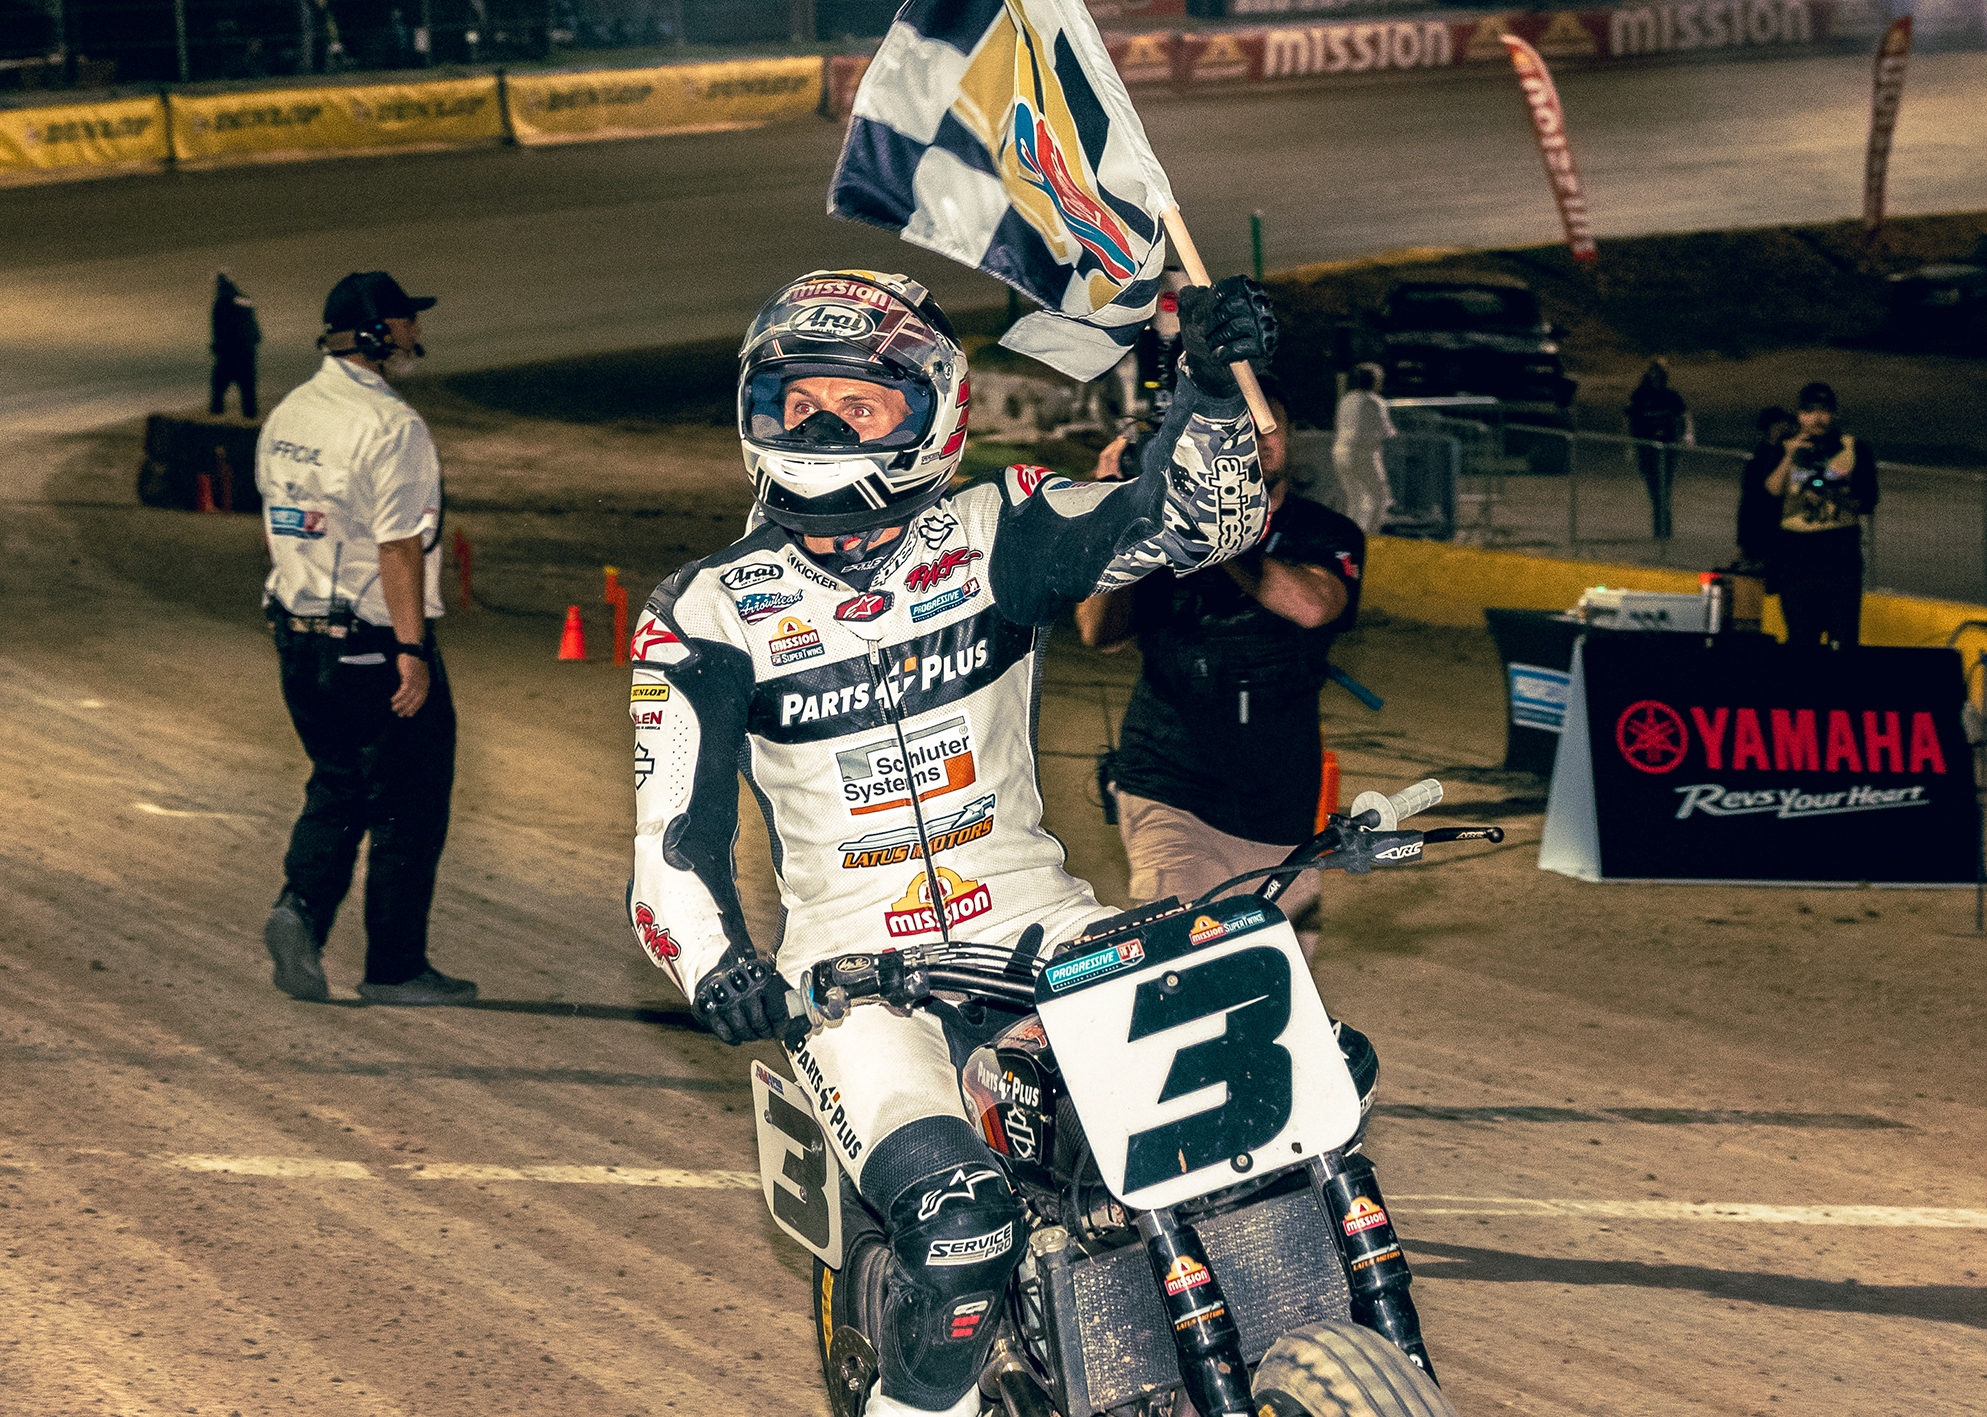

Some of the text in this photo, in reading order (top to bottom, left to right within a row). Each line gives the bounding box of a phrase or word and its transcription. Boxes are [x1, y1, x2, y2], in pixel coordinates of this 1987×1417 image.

[1611, 0, 1811, 57] mission
[1265, 19, 1453, 77] mission
[793, 281, 889, 307] mission
[799, 307, 863, 329] Arai
[726, 564, 777, 585] Arai
[794, 561, 838, 590] KICKER
[740, 588, 804, 615] Arrowhead
[913, 590, 960, 615] PROGRESSIVE
[771, 632, 819, 652] mission
[781, 640, 988, 725] PARTS PLUS
[1690, 707, 1948, 774] YAMAHA
[876, 735, 970, 775] Schluter
[1673, 783, 1926, 819] Revs Your Heart
[843, 843, 911, 868] LATUS
[1375, 841, 1424, 859] ARC
[1192, 926, 1224, 943] mission
[1053, 951, 1115, 981] PROGRESSIVE
[977, 1060, 1039, 1108] PARTS PLUS
[1122, 946, 1293, 1196] 3
[830, 1103, 862, 1160] PLUS
[1346, 1212, 1385, 1232] mission
[930, 1224, 1011, 1257] SERVICE
[984, 1238, 1011, 1257] PRO
[1168, 1269, 1208, 1292] mission
